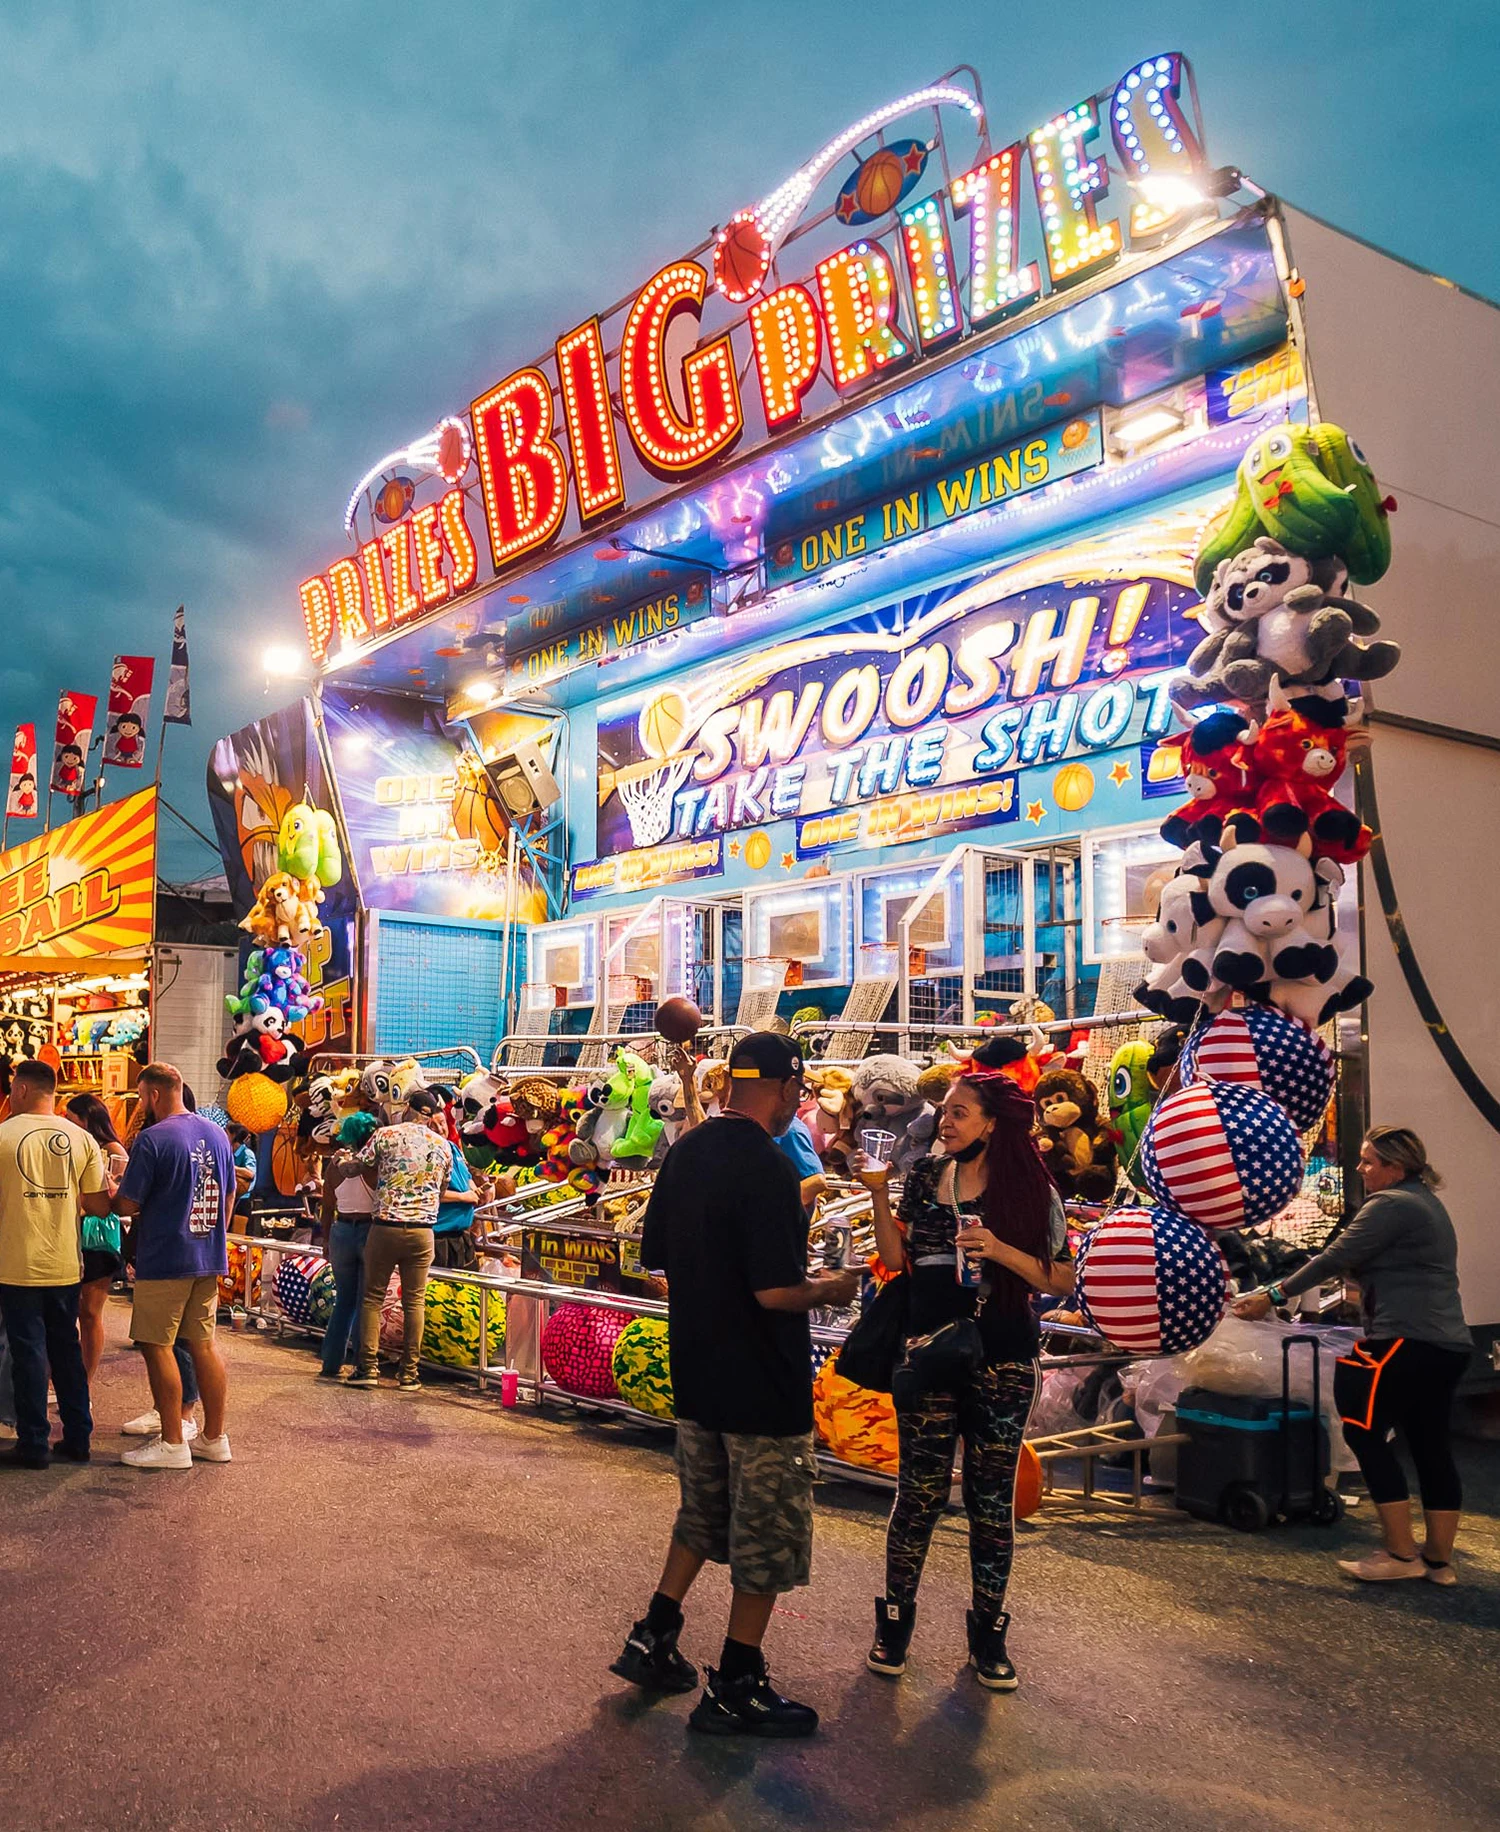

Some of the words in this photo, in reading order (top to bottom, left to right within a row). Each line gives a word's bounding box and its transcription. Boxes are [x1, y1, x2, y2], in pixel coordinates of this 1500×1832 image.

[471, 261, 744, 572] BIG
[747, 51, 1218, 428] PRIZES
[801, 515, 867, 572] ONE
[882, 491, 920, 542] IN
[936, 439, 1049, 518] WINS
[299, 489, 477, 661] PRIZES
[528, 640, 569, 681] ONE
[577, 625, 604, 661] IN
[612, 594, 680, 647] WINS
[693, 582, 1151, 782] SWOOSH!
[375, 774, 458, 806] ONE
[675, 762, 807, 838] TAKE
[827, 726, 944, 803] THE
[973, 665, 1191, 774] SHOT
[800, 812, 860, 849] ONE
[868, 802, 902, 836] IN
[909, 777, 1015, 827] WINS!
[370, 839, 480, 877] WINS
[574, 862, 616, 891] ONE
[620, 857, 645, 881] IN
[648, 838, 720, 876] WINS!
[0, 867, 121, 956] BALL
[526, 1232, 536, 1254] 1
[541, 1234, 559, 1256] in
[564, 1238, 617, 1265] WINS
